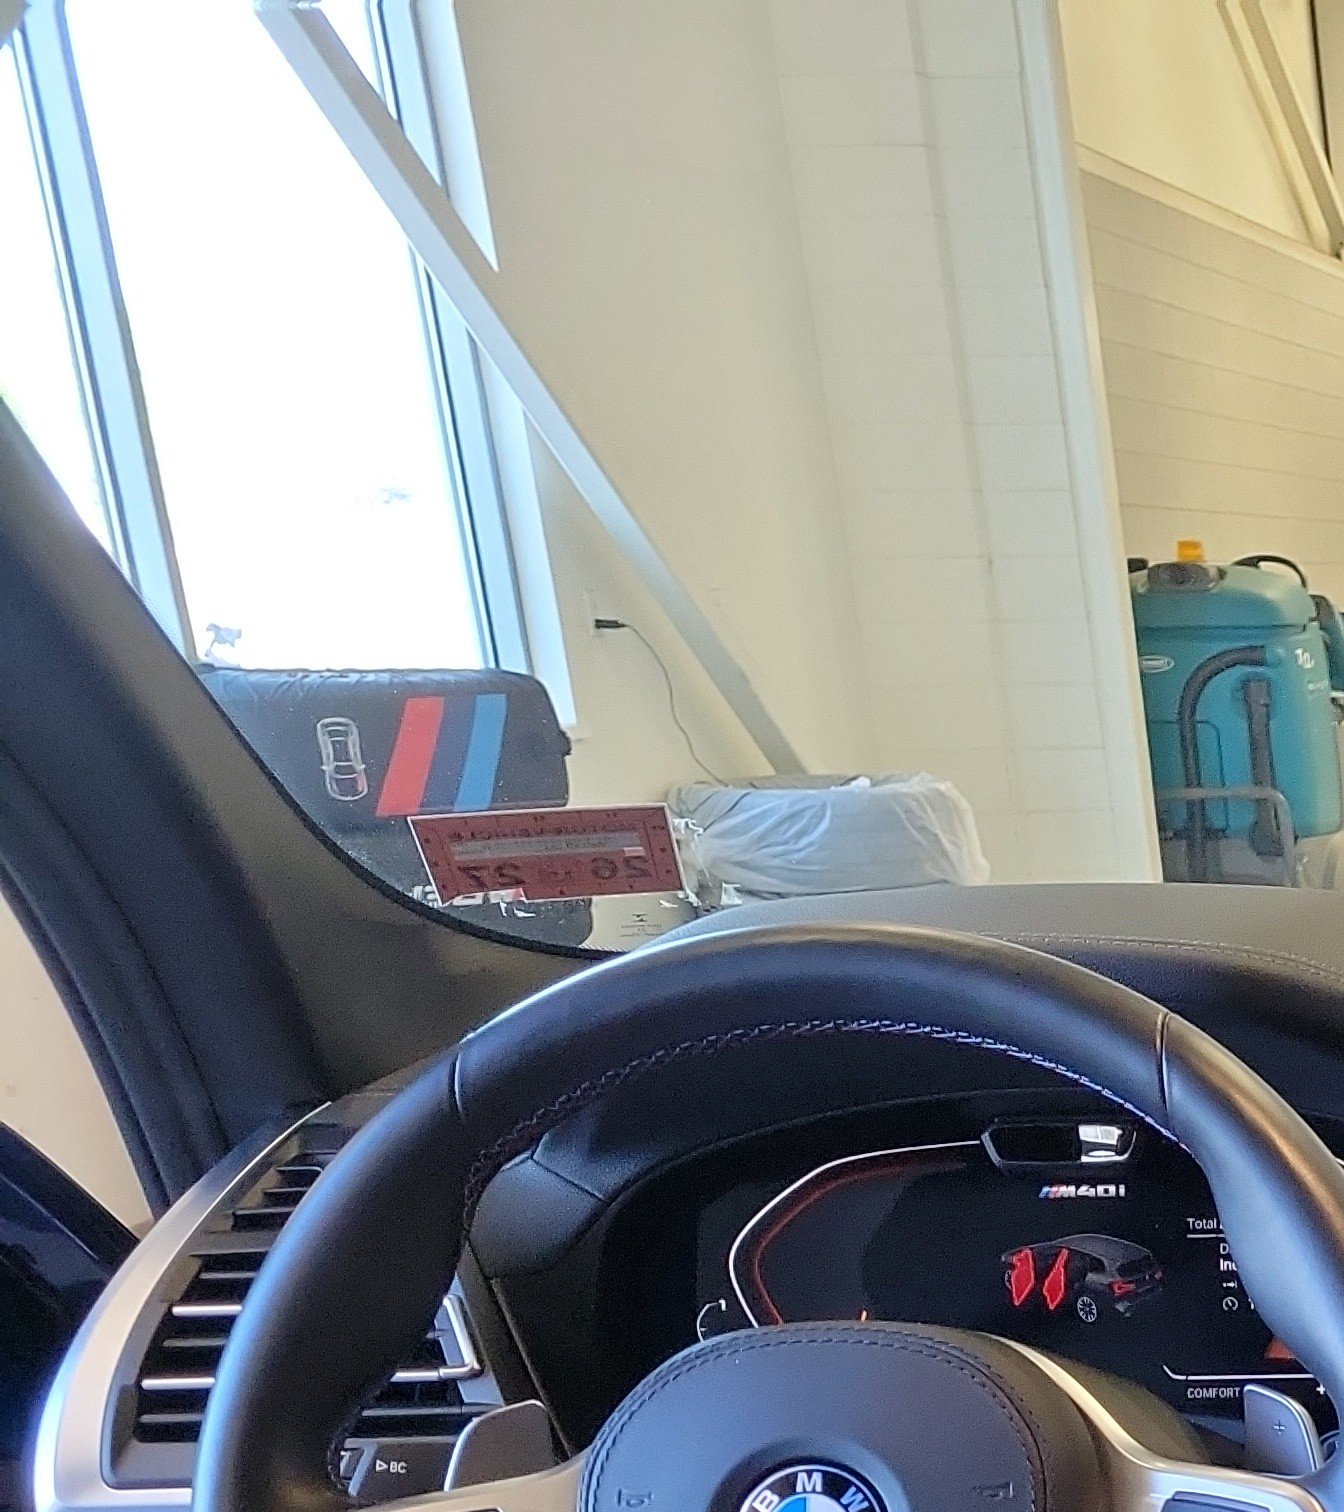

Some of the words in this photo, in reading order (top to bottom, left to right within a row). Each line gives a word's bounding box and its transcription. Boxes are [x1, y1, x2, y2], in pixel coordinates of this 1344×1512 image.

[1054, 1184, 1126, 1198] M40i
[1187, 1218, 1217, 1230] Total
[1187, 1387, 1241, 1399] COMFORT
[390, 1461, 408, 1474] BC
